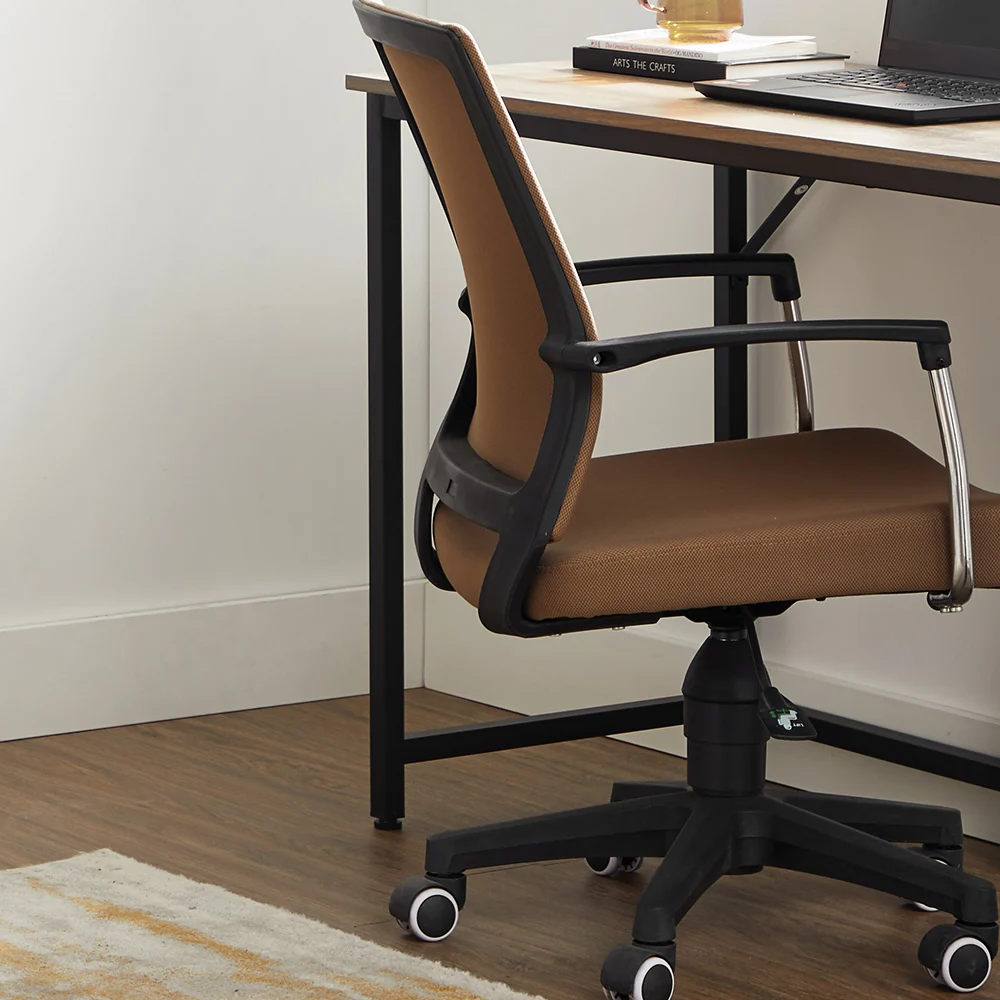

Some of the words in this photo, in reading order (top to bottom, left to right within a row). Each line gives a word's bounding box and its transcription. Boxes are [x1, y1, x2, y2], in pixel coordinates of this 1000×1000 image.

[612, 58, 631, 69] ARTS
[633, 60, 647, 71] THE
[649, 62, 676, 74] CRAFTS
